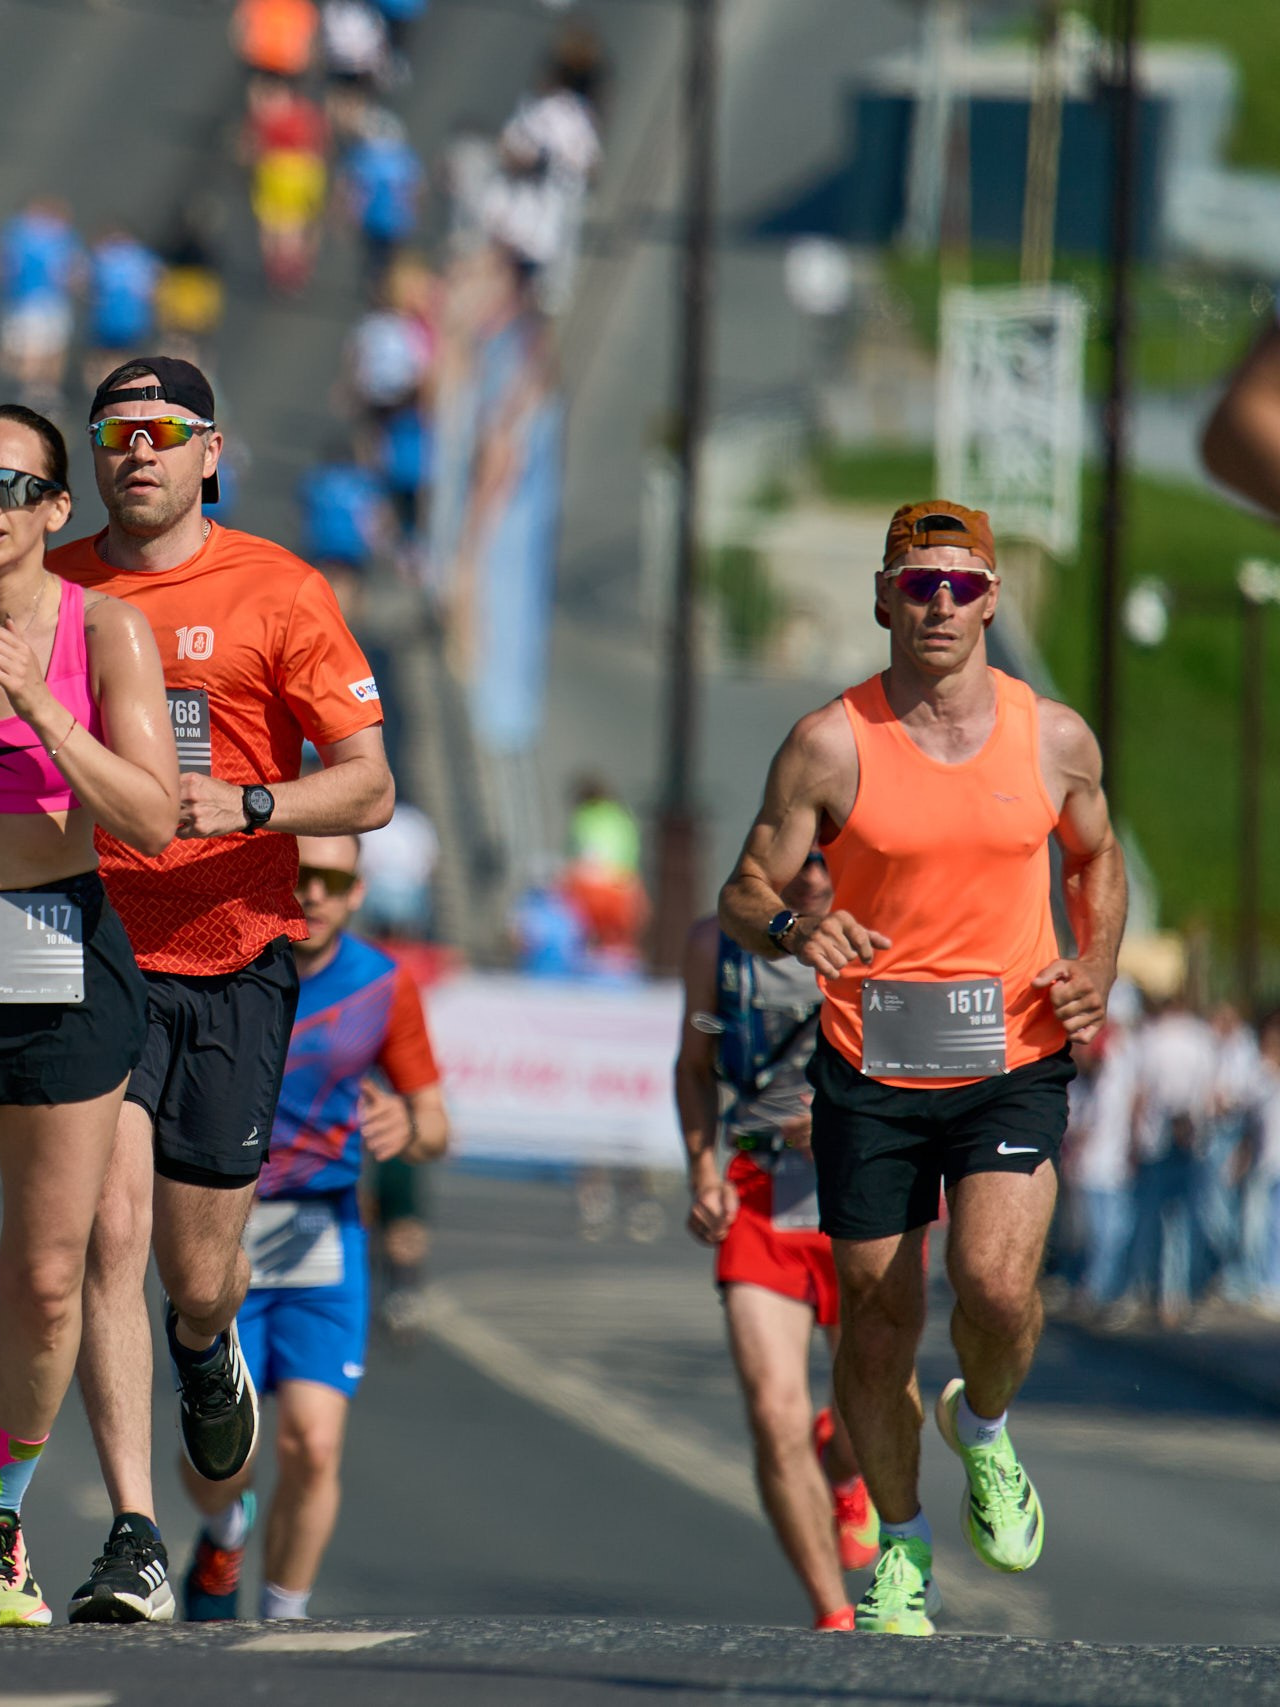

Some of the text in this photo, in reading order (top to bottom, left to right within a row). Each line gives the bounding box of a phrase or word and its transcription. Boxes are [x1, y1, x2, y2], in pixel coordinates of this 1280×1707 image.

[175, 626, 214, 661] 10
[174, 728, 185, 737] 10
[25, 905, 73, 930] 1117
[45, 934, 57, 944] 10
[947, 987, 996, 1014] 1517
[969, 1015, 981, 1025] 10
